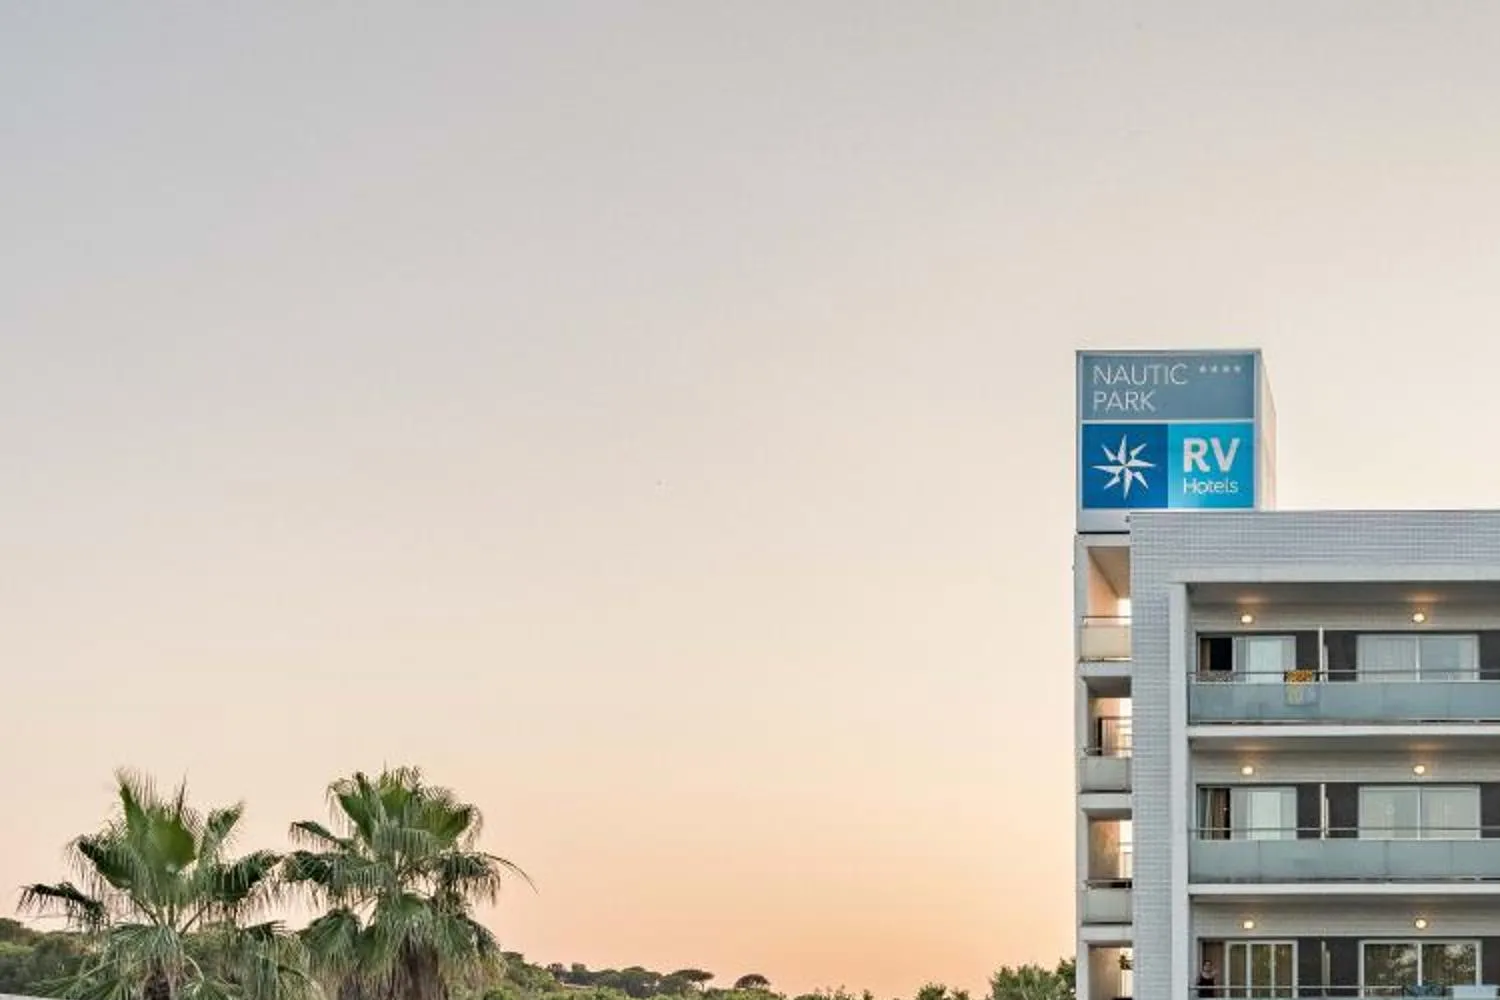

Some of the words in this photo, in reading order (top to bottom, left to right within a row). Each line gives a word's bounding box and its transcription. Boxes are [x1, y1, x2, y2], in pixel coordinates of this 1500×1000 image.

[1092, 363, 1189, 385] NAUTIC
[1092, 390, 1157, 413] PARK
[1183, 437, 1241, 473] RV
[1183, 476, 1239, 494] Hotels
